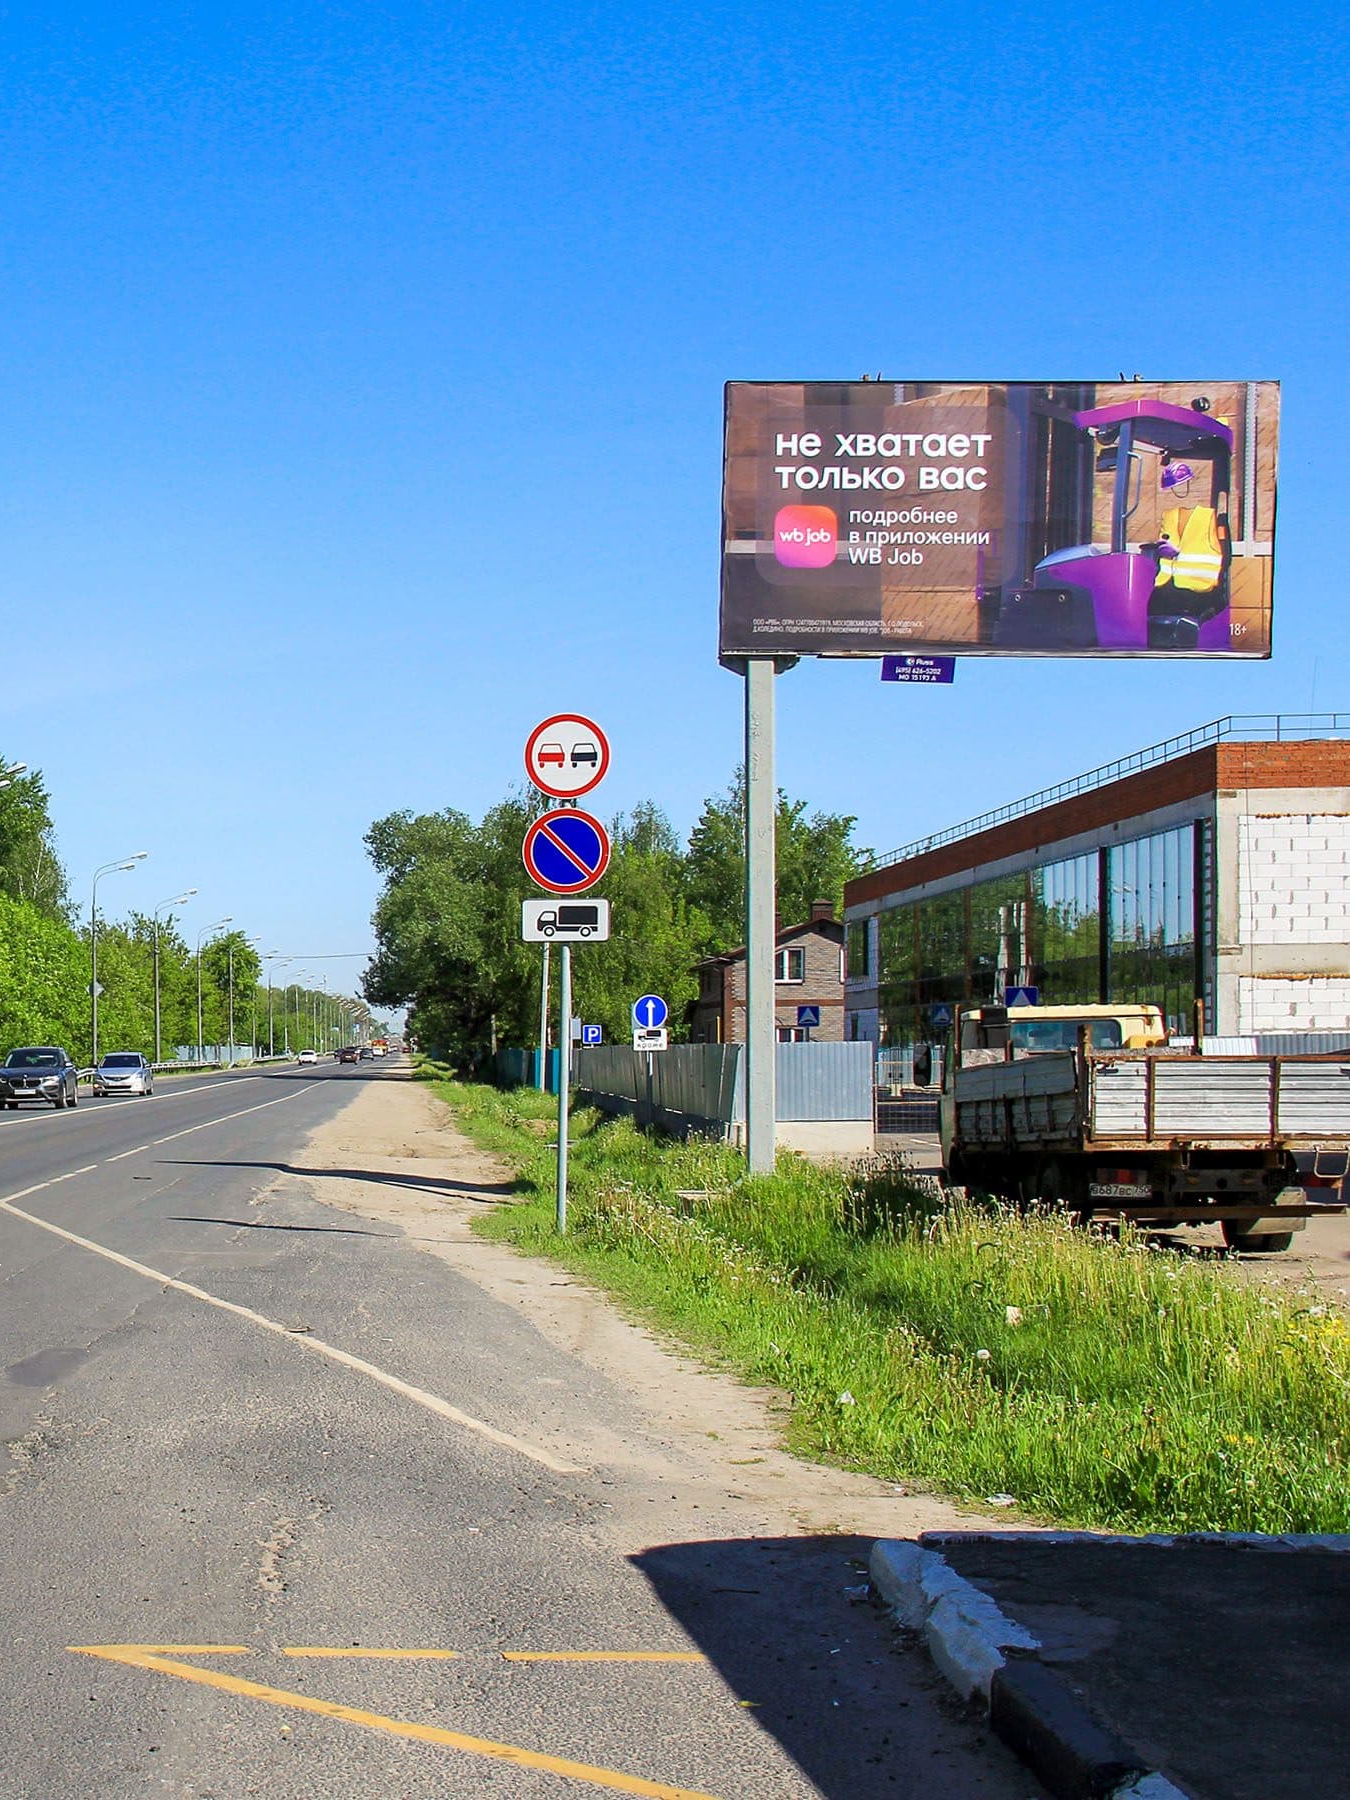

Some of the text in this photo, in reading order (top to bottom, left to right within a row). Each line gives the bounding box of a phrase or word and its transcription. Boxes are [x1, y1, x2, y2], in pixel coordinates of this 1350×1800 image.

[776, 433, 992, 457] не хватает
[775, 466, 988, 490] только вас
[849, 506, 958, 527] подробнее
[779, 527, 831, 546] wb job
[849, 531, 990, 547] в приложении
[849, 548, 923, 565] WB Job
[1229, 622, 1248, 636] 18+
[588, 1027, 599, 1042] P
